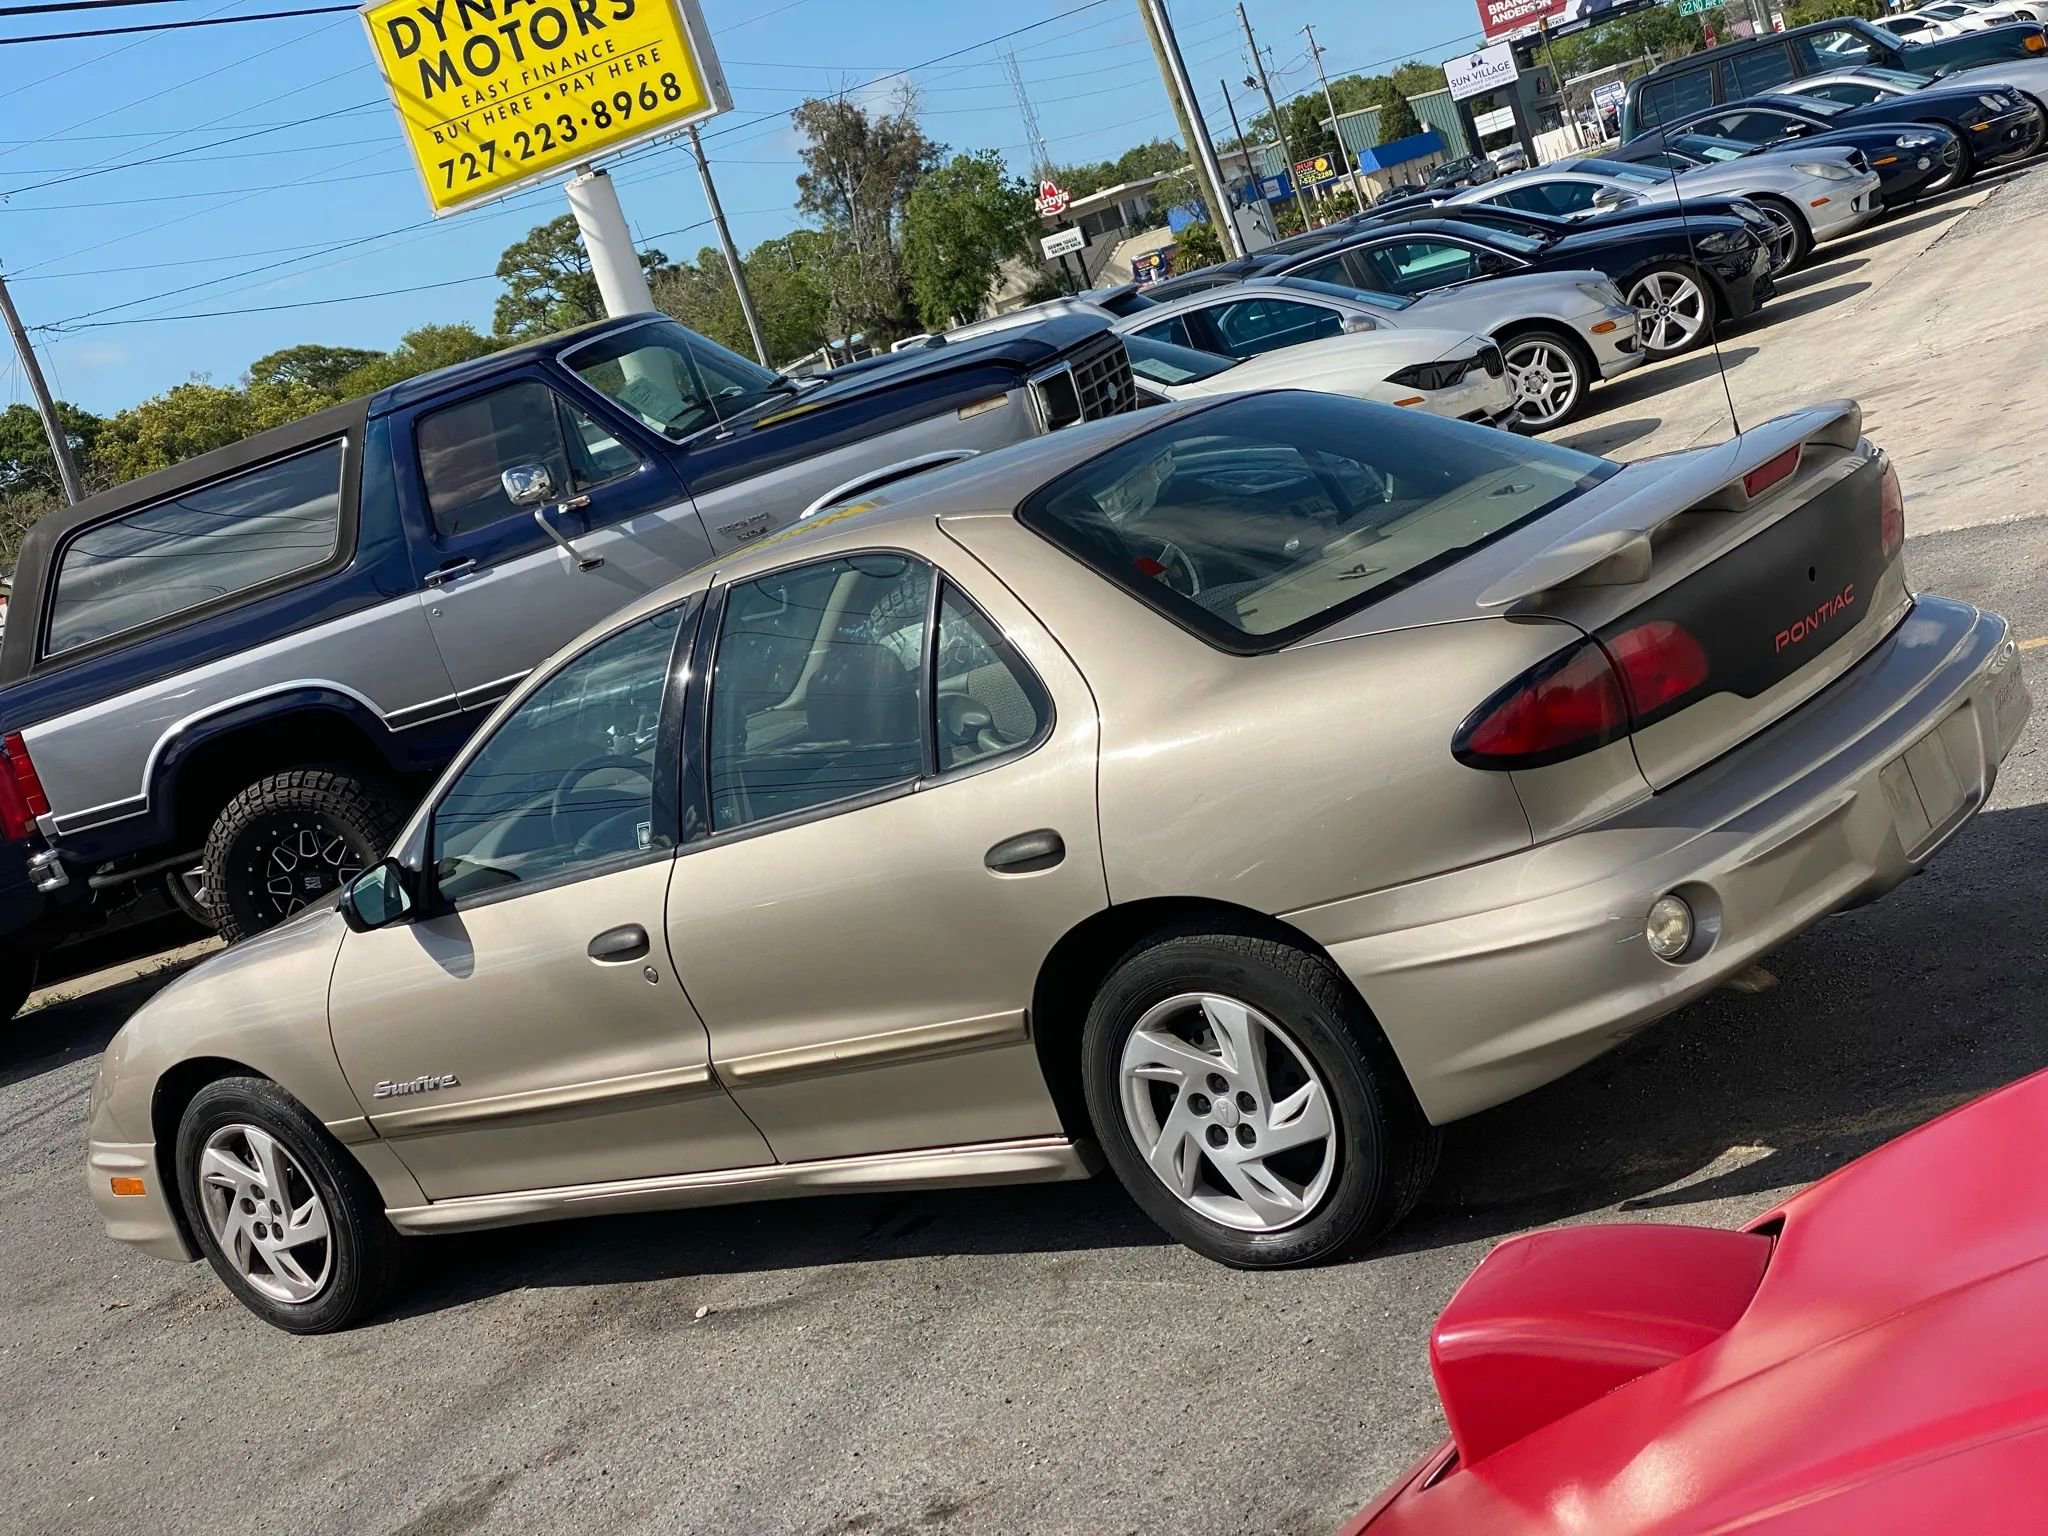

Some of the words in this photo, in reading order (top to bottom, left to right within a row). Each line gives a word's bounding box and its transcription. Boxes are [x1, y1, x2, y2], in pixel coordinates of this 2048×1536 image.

[387, 0, 536, 59] DYN
[1492, 0, 1552, 25] ANDERSON
[461, 79, 509, 109] EASY
[521, 39, 615, 86] FINANCE
[1450, 75, 1471, 88] SUN
[1472, 60, 1511, 79] VILLAGE
[433, 119, 470, 144] BUY
[483, 96, 533, 126] HERE
[559, 71, 595, 97] PAY
[608, 48, 661, 79] HERE
[1034, 189, 1070, 211] Arby's
[1775, 583, 1855, 654] PONTIAC
[373, 1074, 458, 1098] Sunfire
